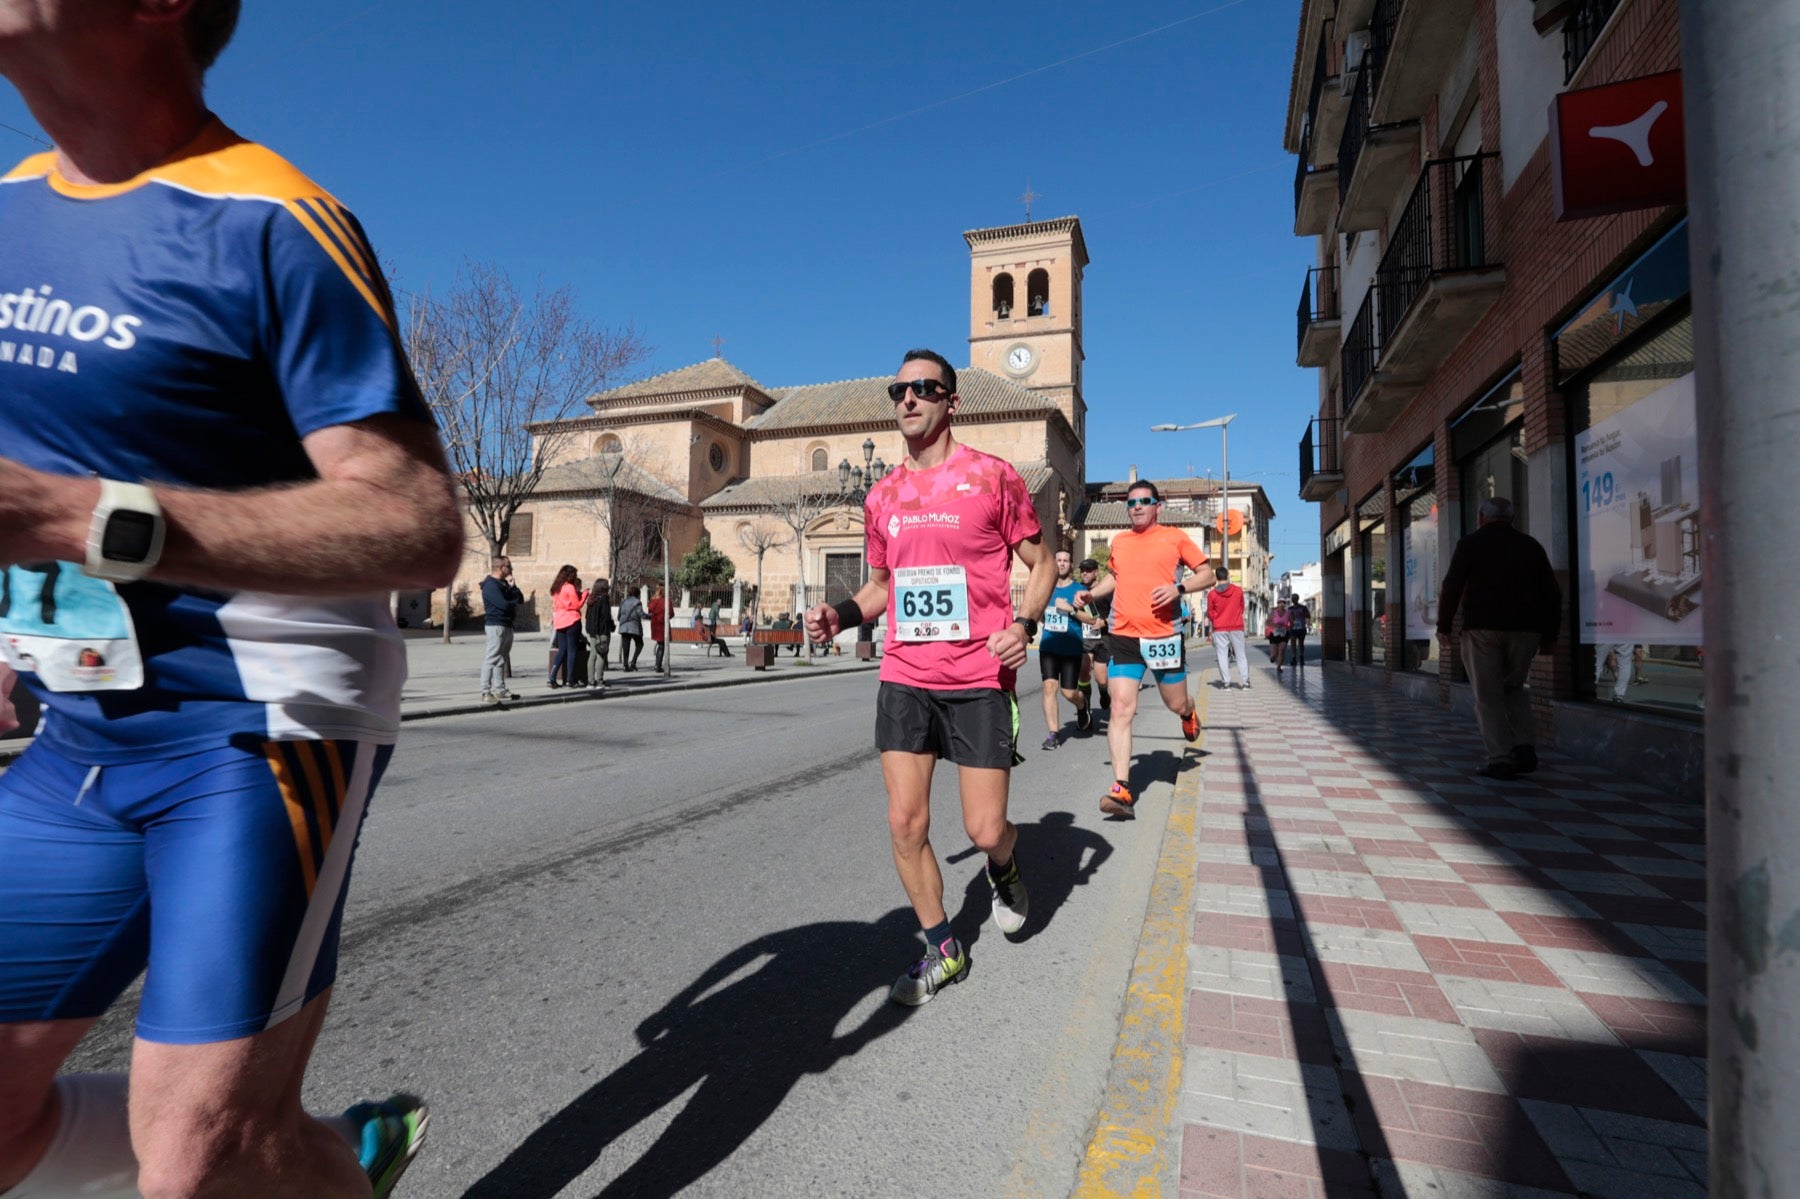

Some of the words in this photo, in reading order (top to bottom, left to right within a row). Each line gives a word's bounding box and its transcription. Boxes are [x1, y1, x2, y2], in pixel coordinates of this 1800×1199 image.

[1582, 471, 1614, 512] 149
[902, 515, 928, 525] PABLO
[929, 512, 960, 525] MUÑOZ
[936, 567, 943, 576] DE
[943, 566, 961, 576] FONDO
[903, 590, 953, 618] 635
[1047, 614, 1063, 624] 751
[1148, 643, 1177, 657] 533
